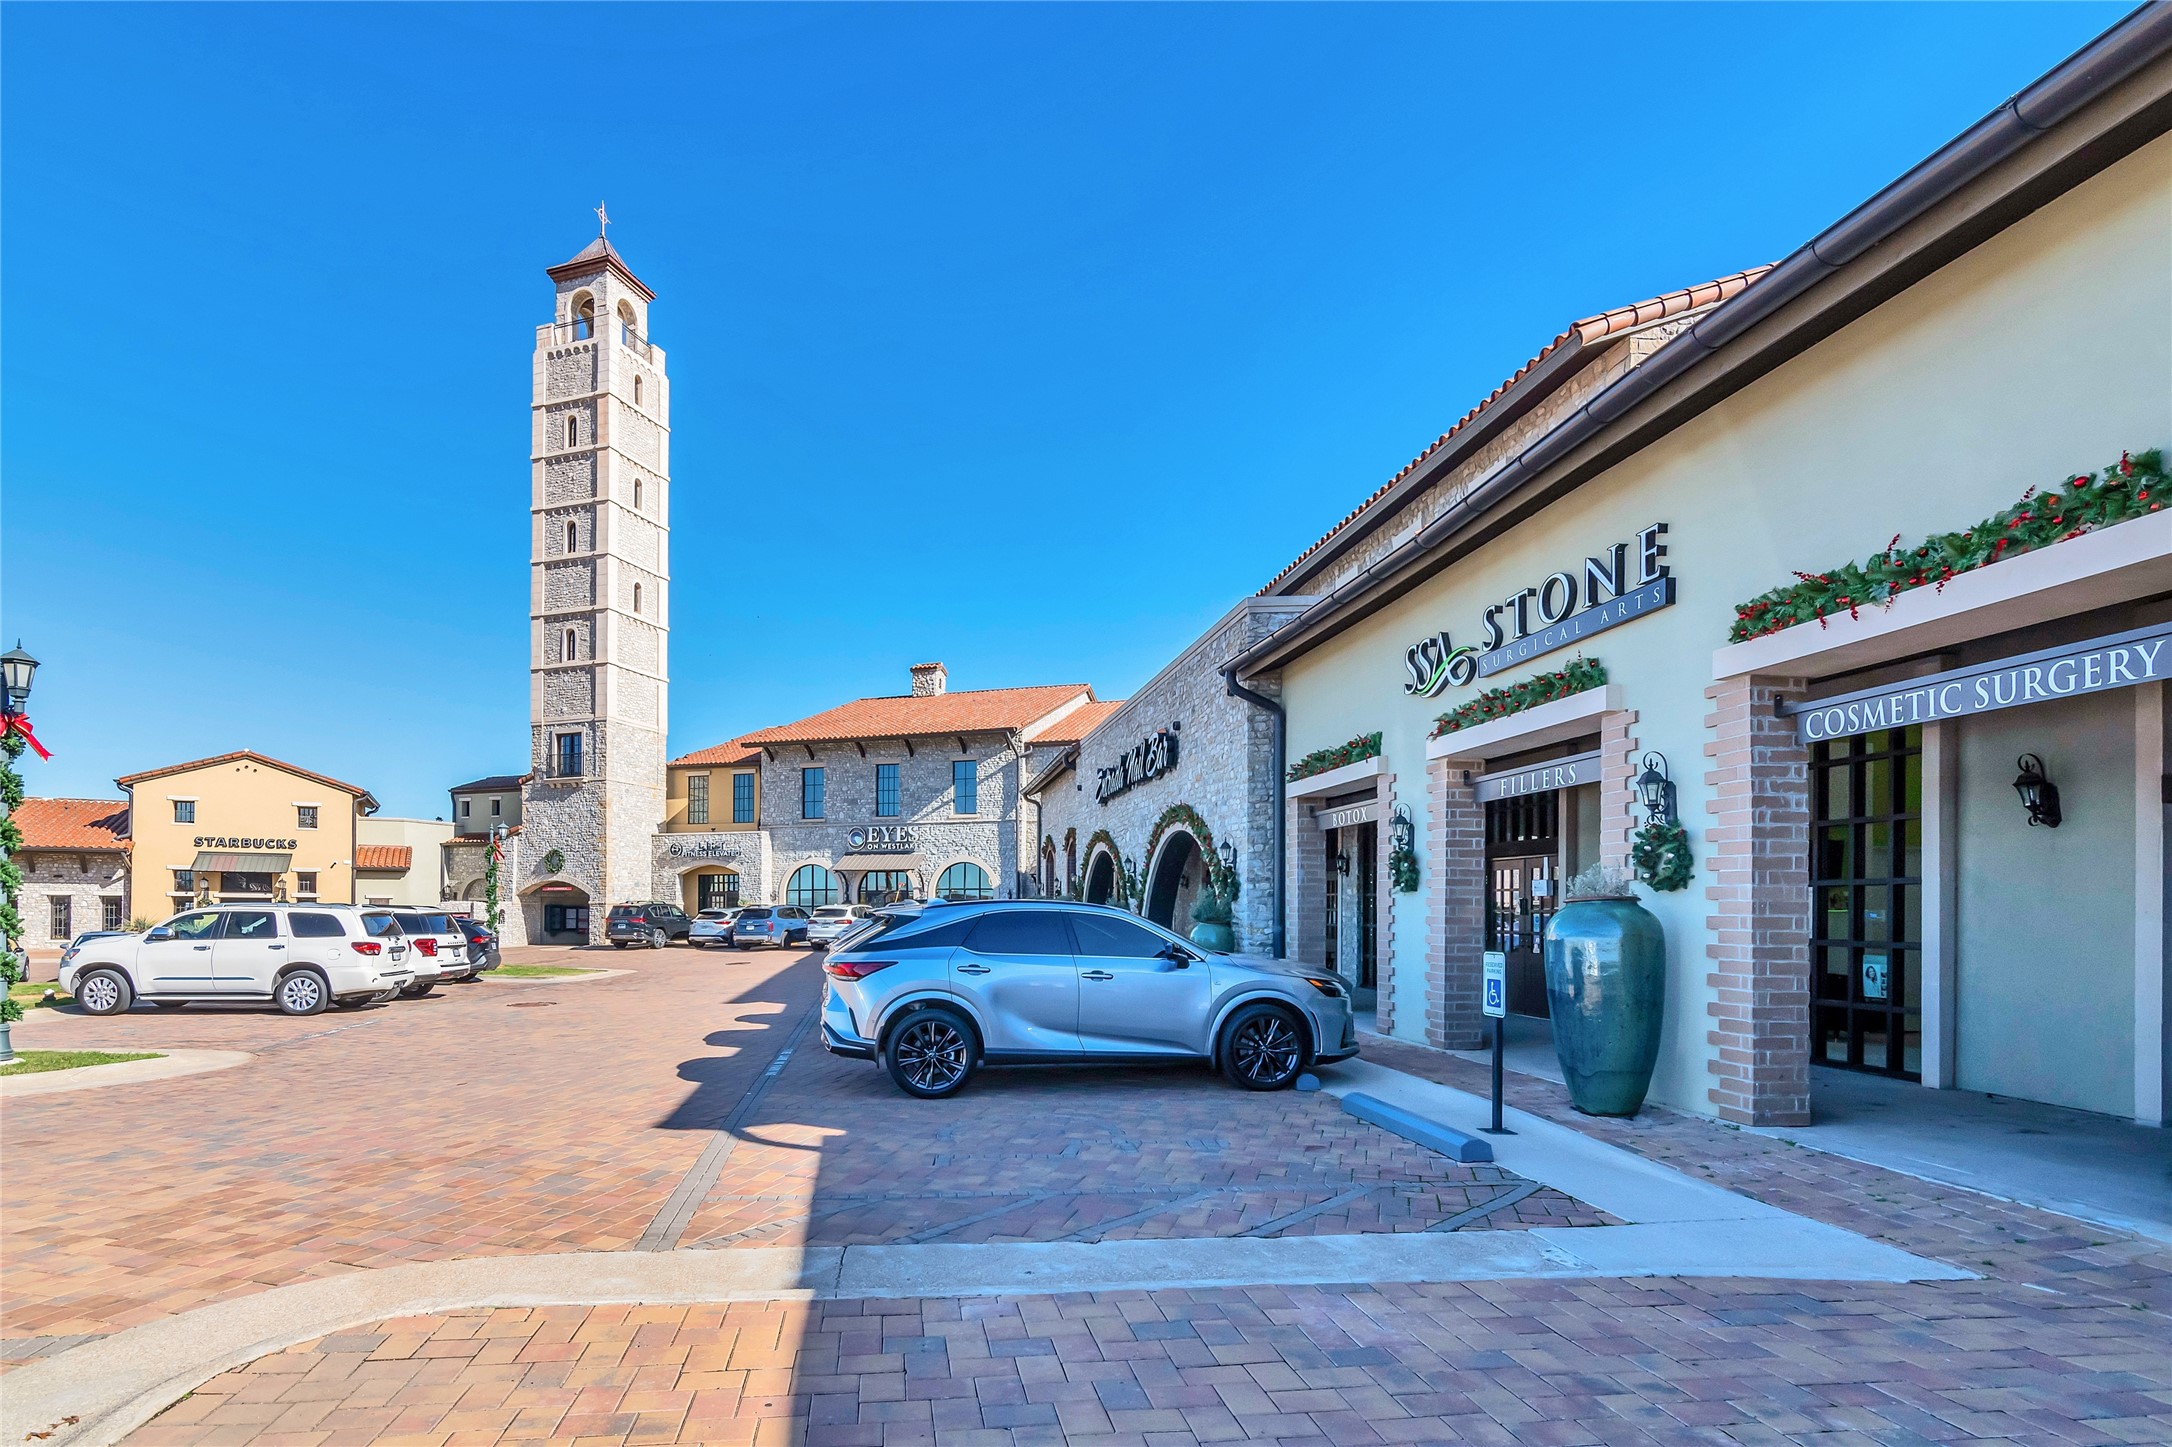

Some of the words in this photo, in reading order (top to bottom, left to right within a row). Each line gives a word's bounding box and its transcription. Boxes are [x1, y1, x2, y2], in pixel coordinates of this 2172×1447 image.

[1482, 522, 1671, 652] STONE
[1482, 620, 1582, 672] SURGICAL
[1599, 586, 1661, 624] ARTS
[1804, 684, 1963, 739] COSMETIC
[1973, 639, 2167, 709] SURGERY
[1146, 732, 1169, 777] Bar
[1500, 763, 1577, 797] FILLERS
[866, 826, 920, 843] EYES
[1332, 806, 1368, 827] BOTOX
[193, 836, 298, 850] STARBUCKS
